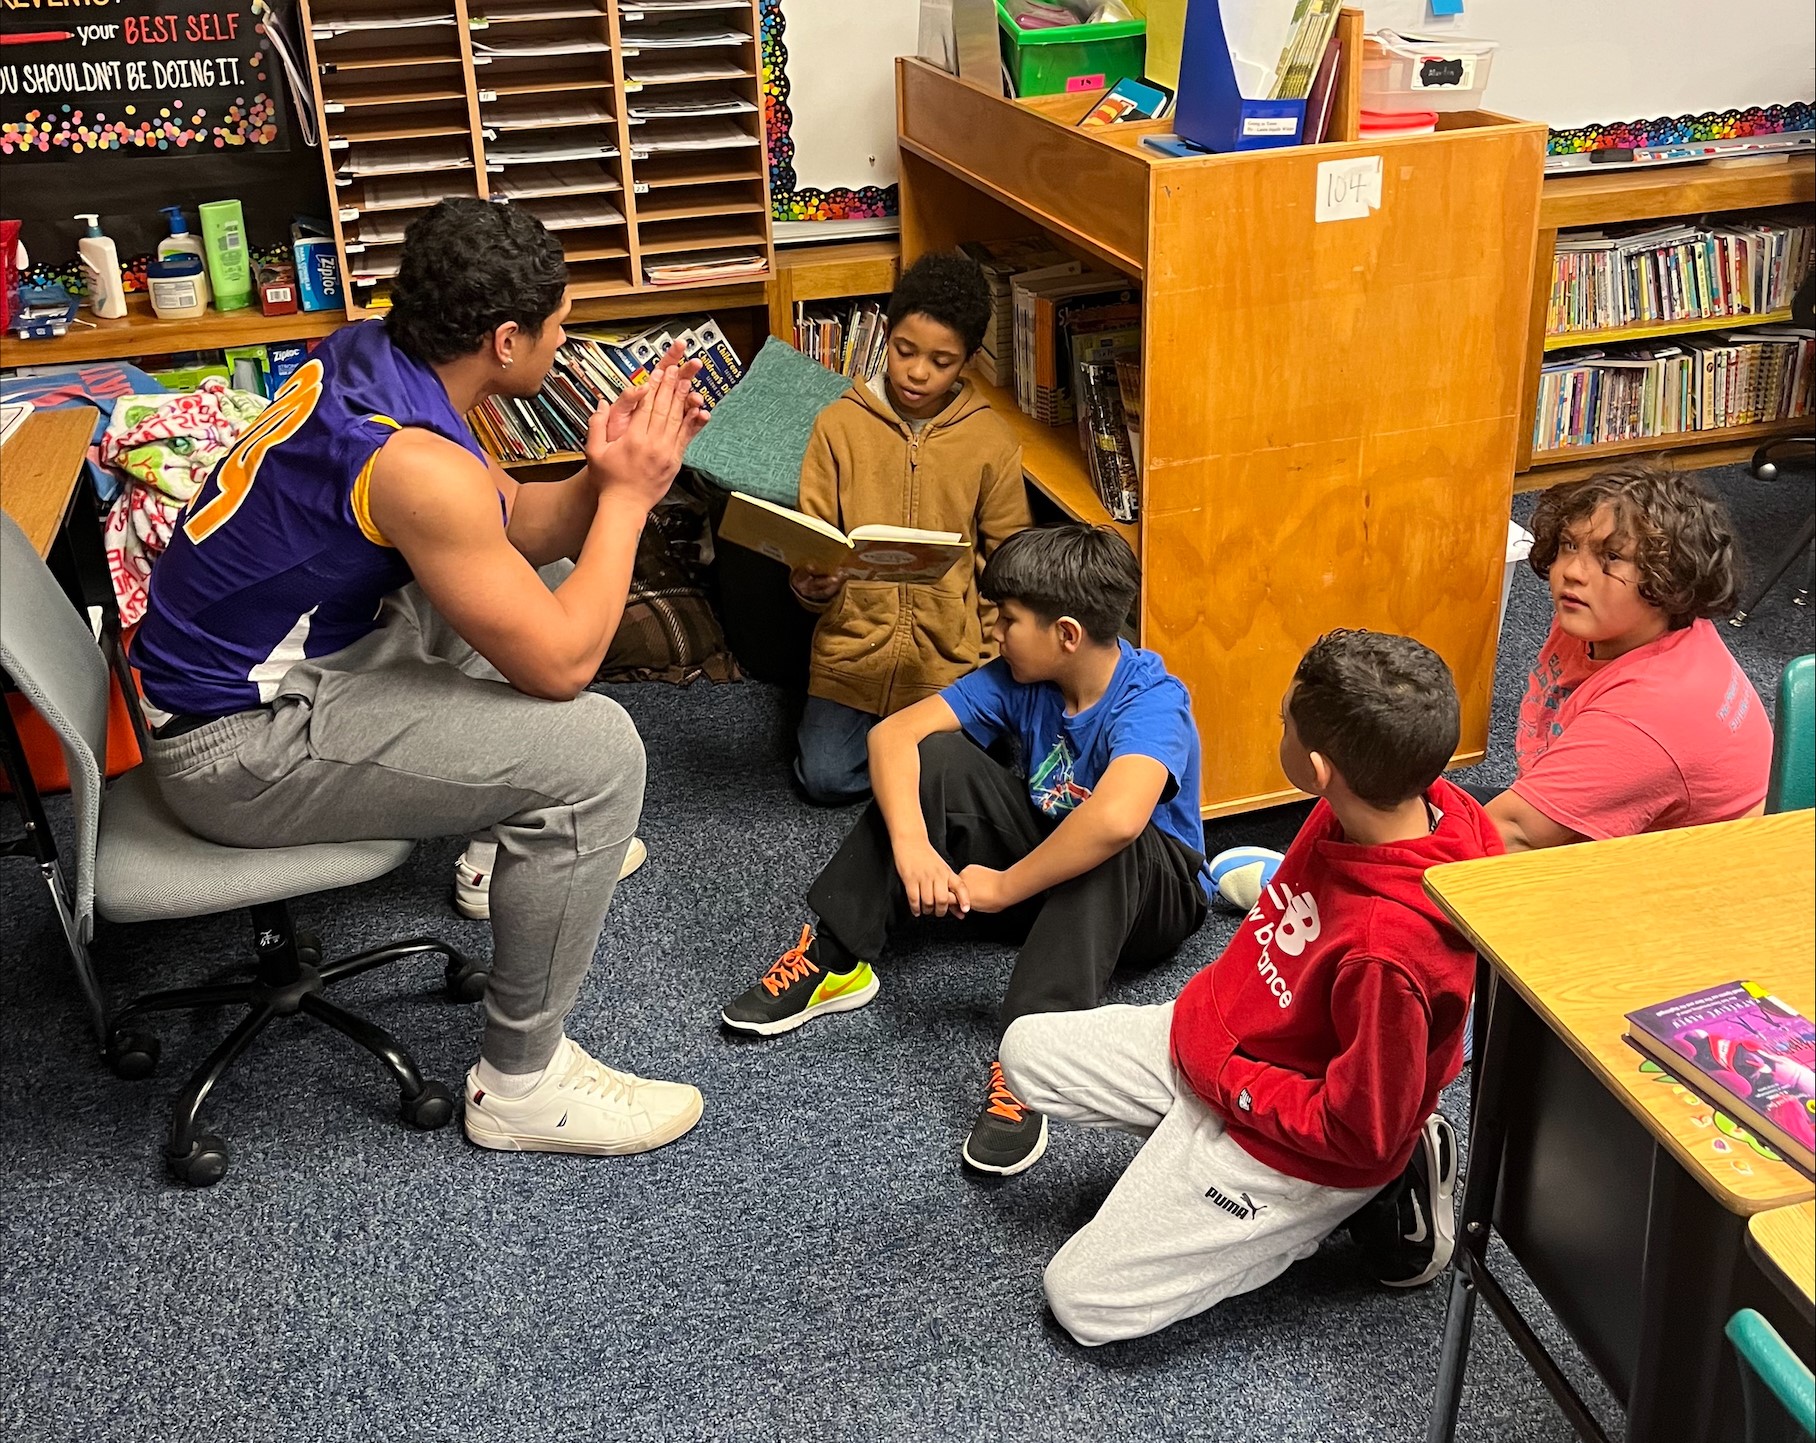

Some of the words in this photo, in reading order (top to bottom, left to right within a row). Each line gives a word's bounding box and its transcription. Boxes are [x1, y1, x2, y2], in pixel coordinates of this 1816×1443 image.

[76, 24, 119, 46] your
[124, 15, 178, 44] BEST
[185, 13, 240, 41] SELF
[22, 60, 121, 94] SHOULDN'T
[126, 60, 152, 91] BE
[152, 59, 215, 89] DOING
[215, 57, 245, 86] IT.
[1327, 173, 1367, 207] 104
[317, 257, 336, 296] Ziploc
[273, 349, 300, 362] Ziploc
[613, 347, 637, 373] LONGMAN
[698, 350, 723, 385] Children's
[717, 343, 742, 379] Children's
[1205, 1186, 1249, 1220] PUMA
